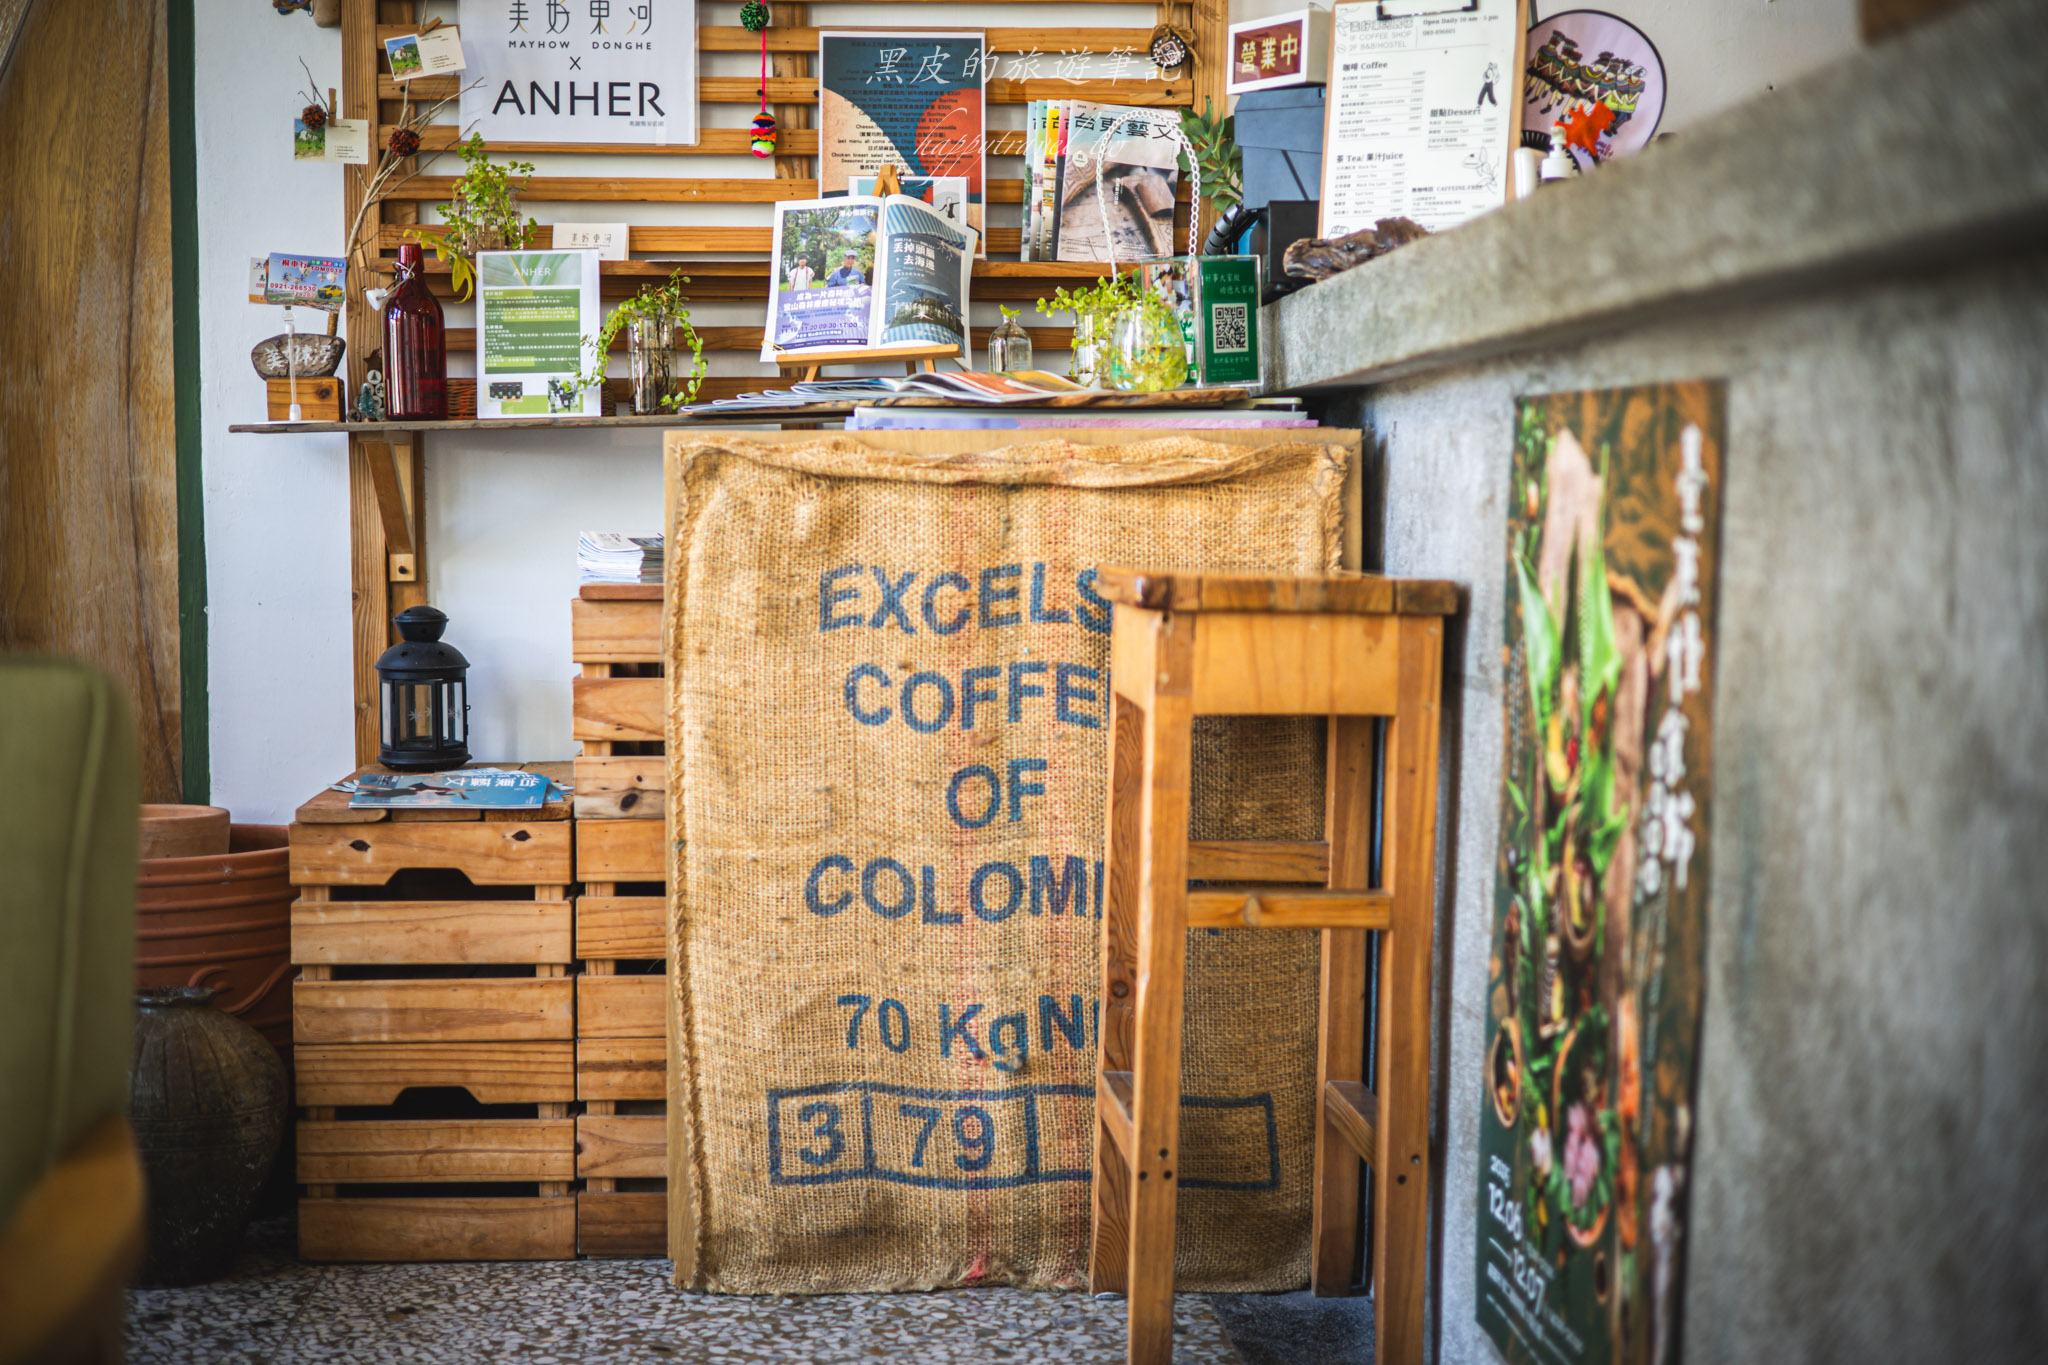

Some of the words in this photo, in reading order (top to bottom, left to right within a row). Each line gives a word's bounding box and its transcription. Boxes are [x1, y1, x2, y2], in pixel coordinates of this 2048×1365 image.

[508, 40, 570, 49] MAYHOW
[592, 41, 652, 50] DONGHE
[1241, 33, 1298, 73] 營業中
[1360, 61, 1388, 70] Coffee
[491, 80, 665, 117] ANHER
[1074, 112, 1176, 142] 台東藝文
[819, 561, 1113, 635] EXCELS
[843, 660, 1110, 734] COFFE
[945, 757, 1047, 829] OF
[804, 854, 1103, 924] COLOM
[836, 993, 911, 1054] 70
[937, 1002, 1030, 1073] Kg
[1039, 993, 1100, 1053] N
[798, 1101, 846, 1166] 3
[899, 1102, 995, 1171] 79
